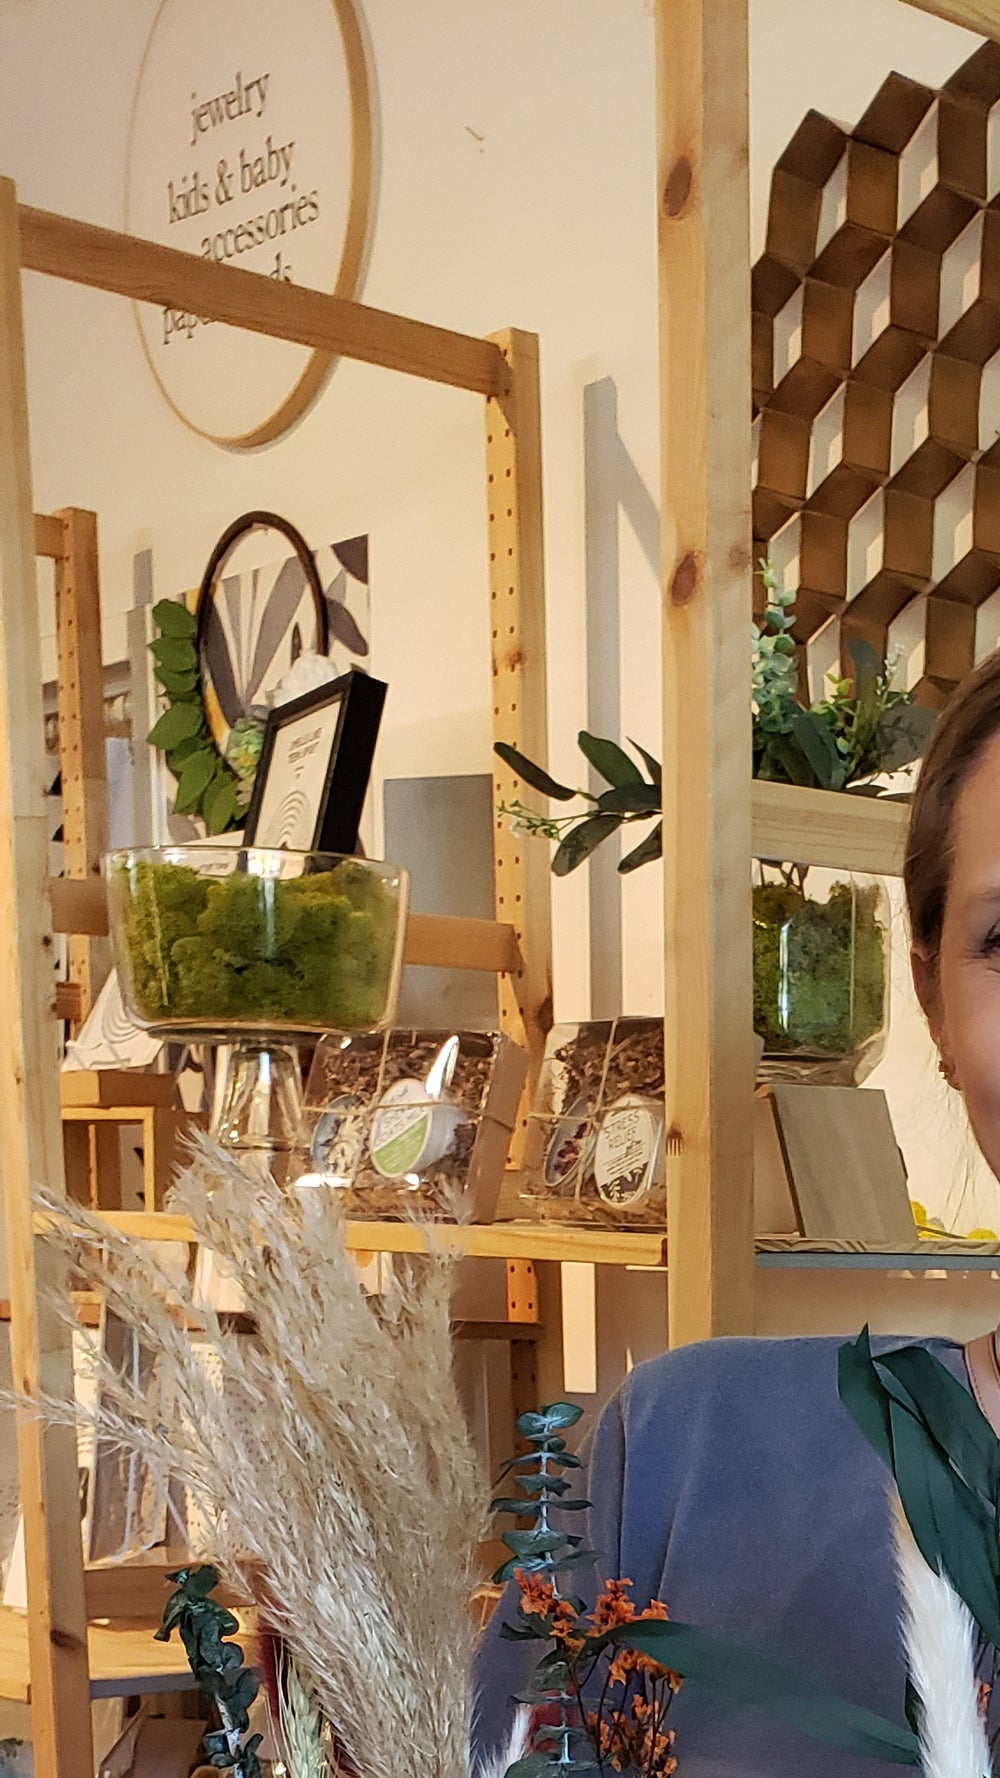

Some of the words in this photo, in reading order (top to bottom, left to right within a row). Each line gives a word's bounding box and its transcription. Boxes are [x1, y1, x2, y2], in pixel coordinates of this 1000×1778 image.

[190, 71, 270, 147] jewelry
[167, 171, 211, 225] kids
[214, 158, 234, 206] &
[239, 135, 296, 194] baby
[200, 184, 321, 263] accessories
